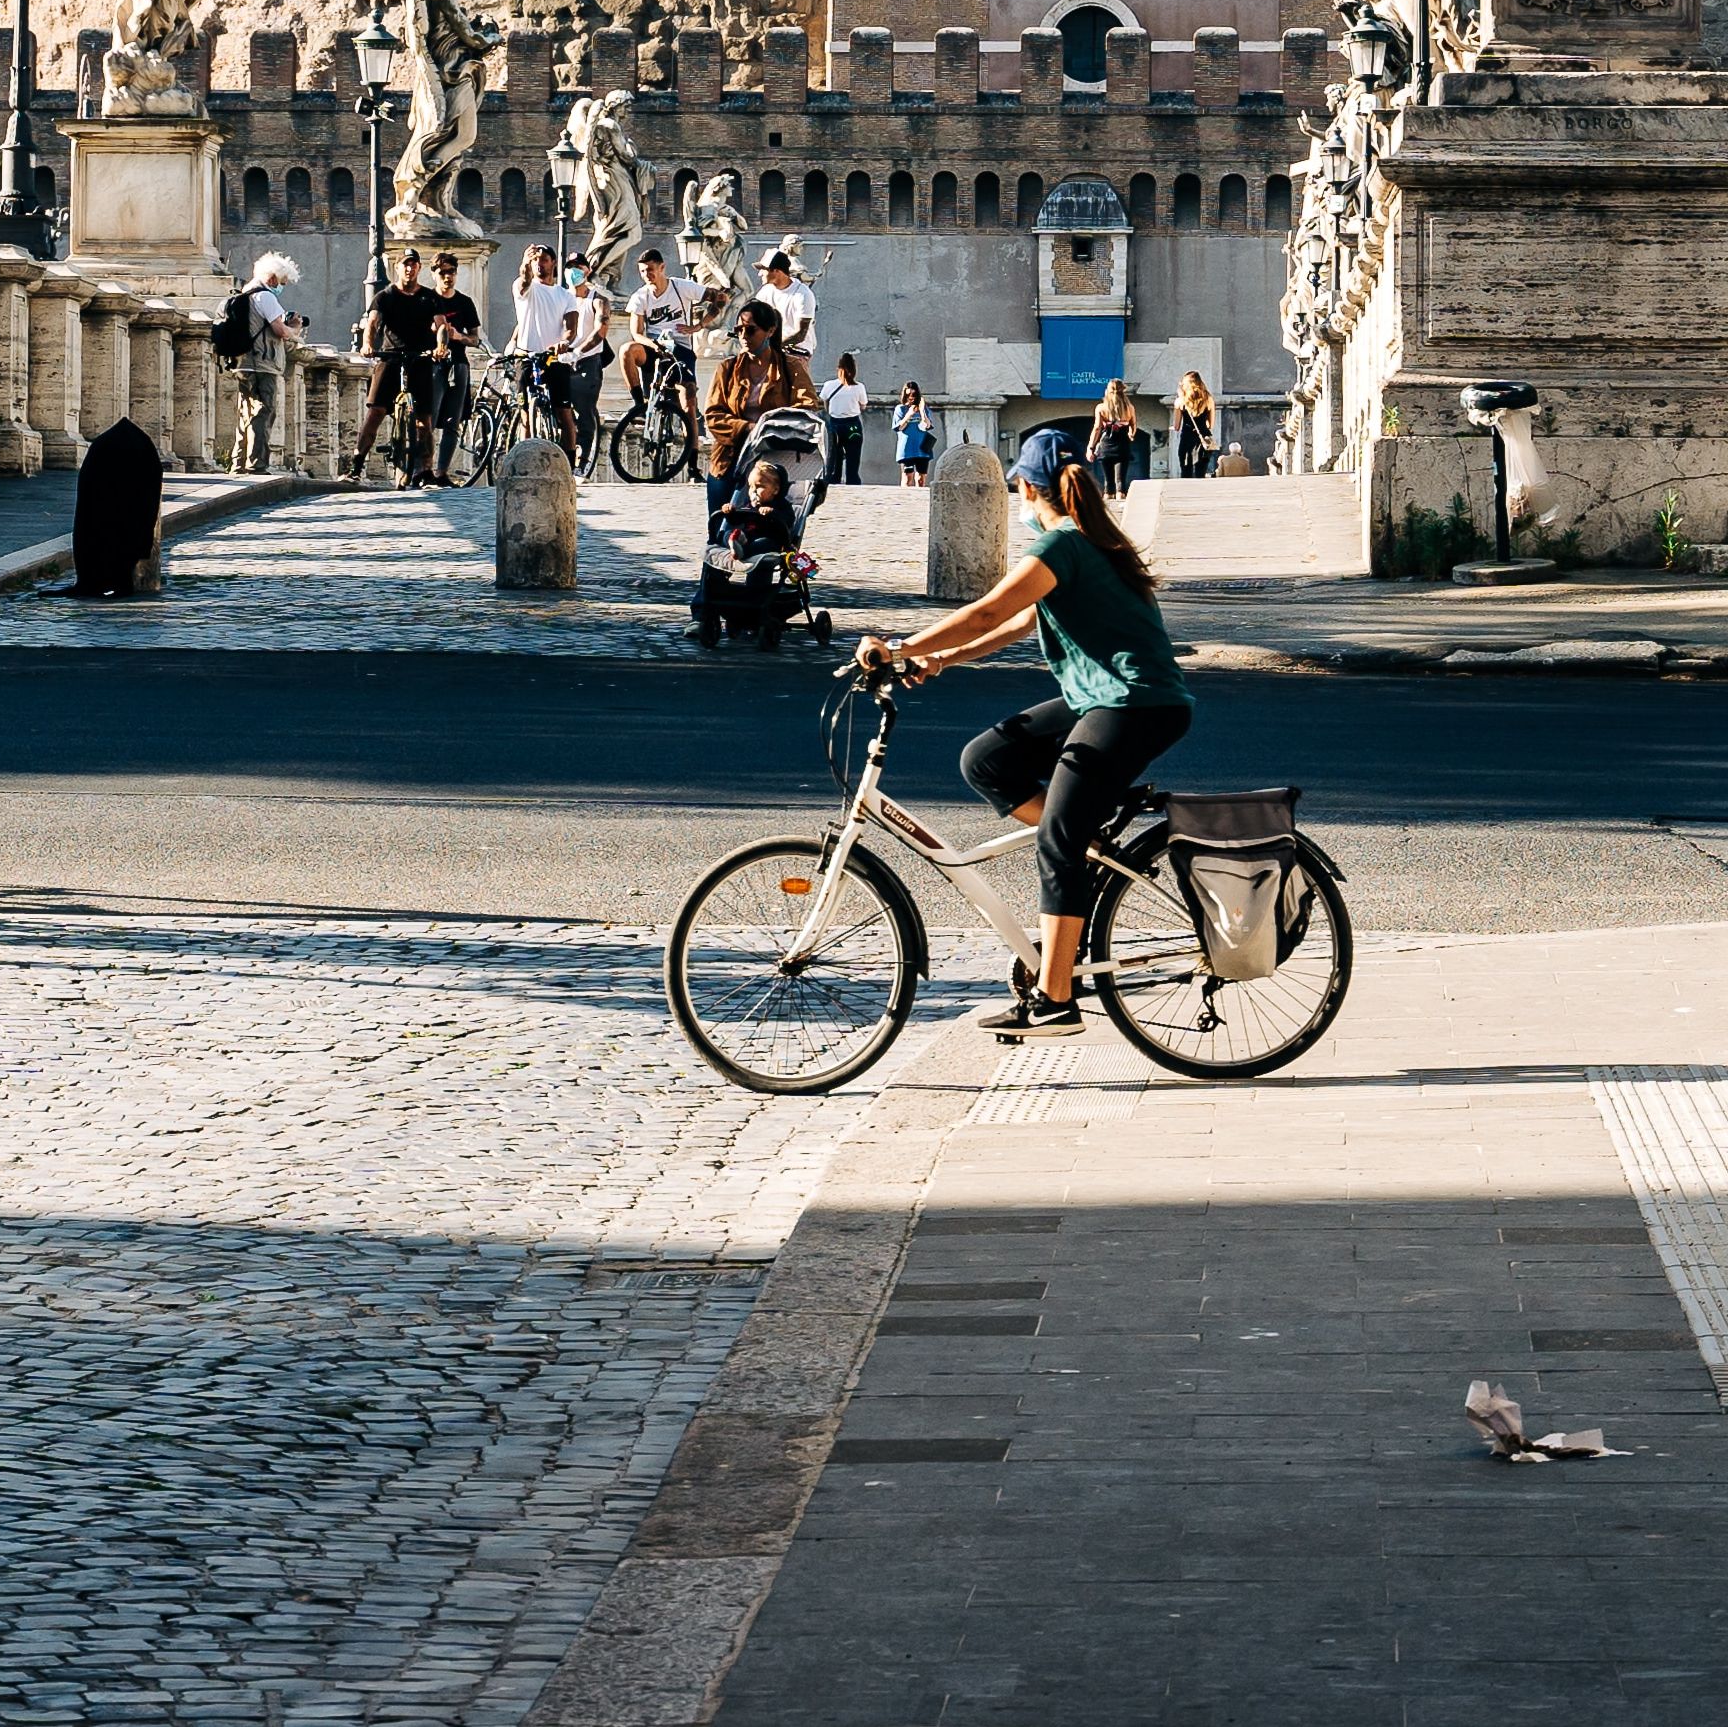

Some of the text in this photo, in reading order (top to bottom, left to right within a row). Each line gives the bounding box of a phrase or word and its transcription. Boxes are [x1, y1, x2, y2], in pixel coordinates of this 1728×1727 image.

[1565, 117, 1633, 130] BORGO
[651, 304, 671, 319] NIKE
[883, 804, 916, 833] btwin
